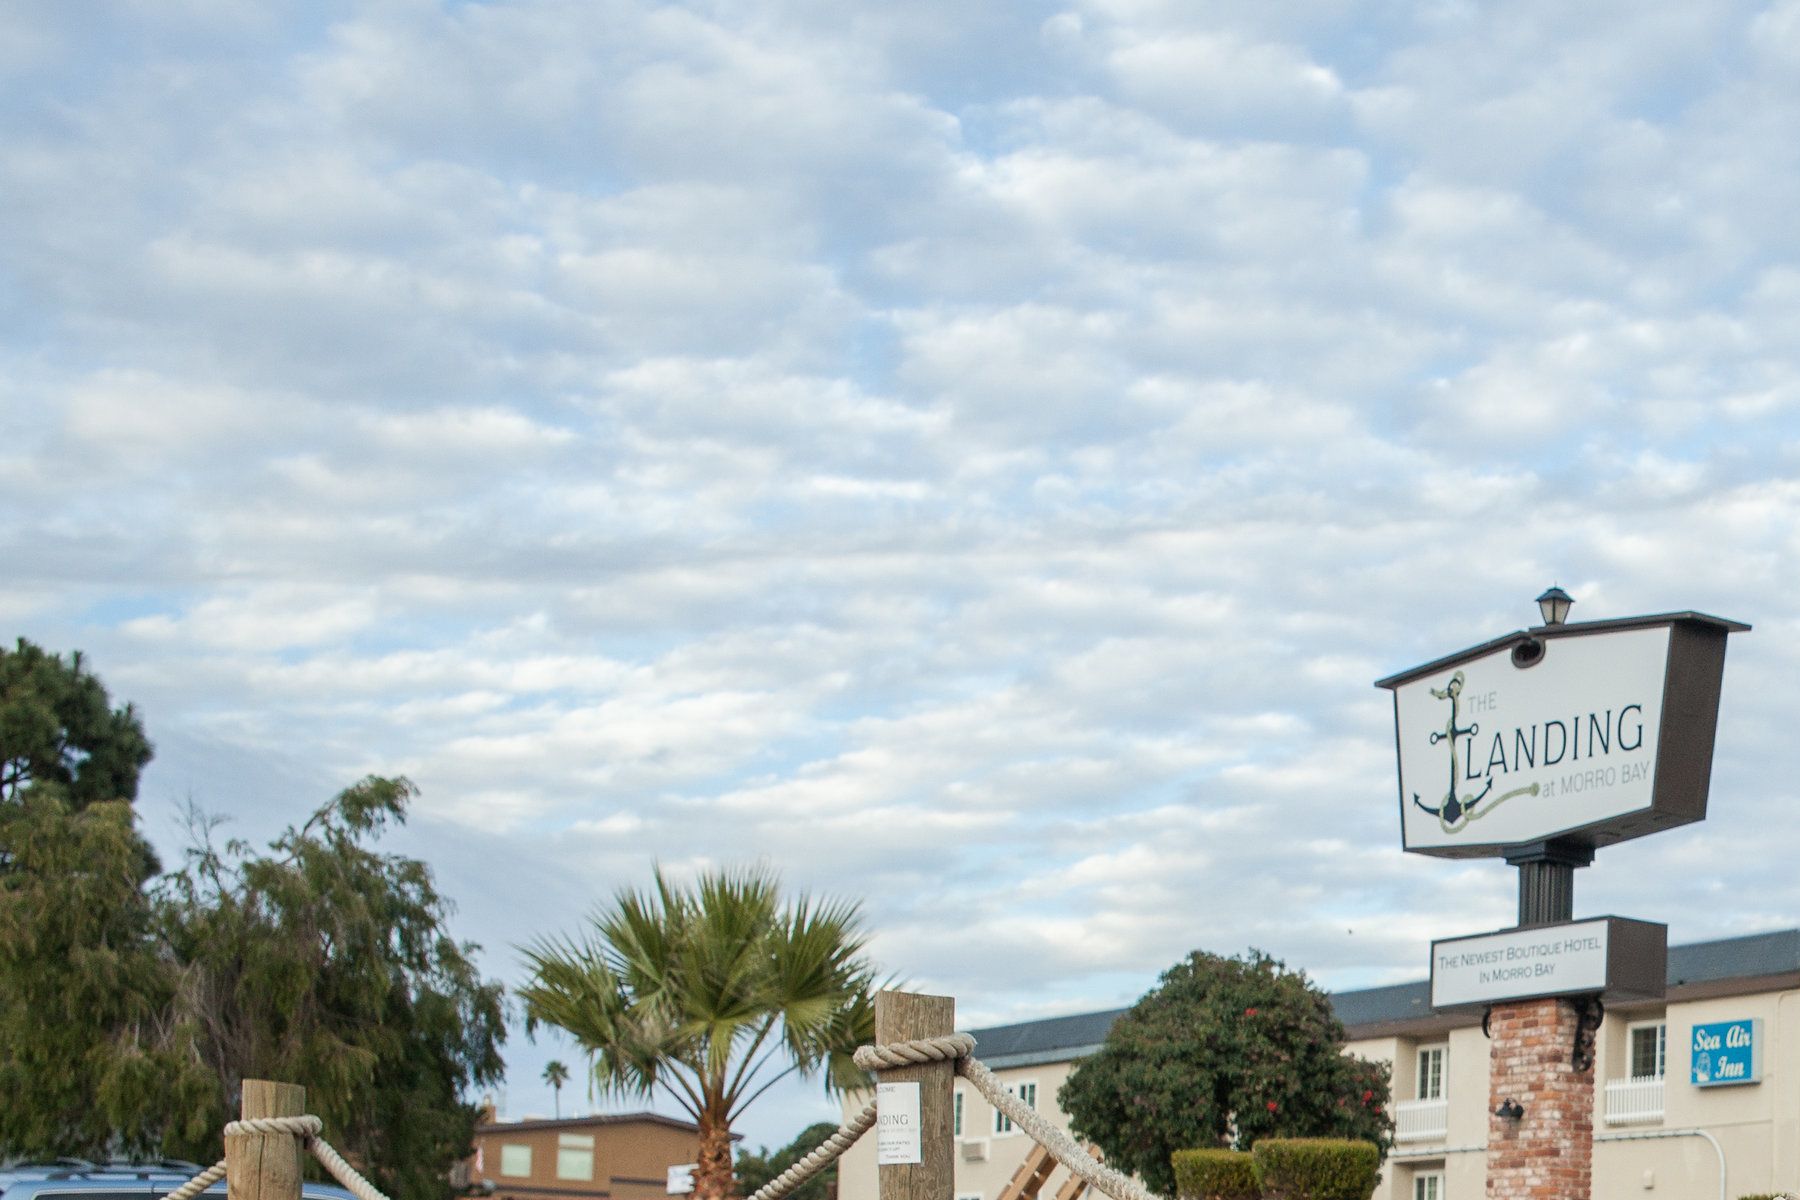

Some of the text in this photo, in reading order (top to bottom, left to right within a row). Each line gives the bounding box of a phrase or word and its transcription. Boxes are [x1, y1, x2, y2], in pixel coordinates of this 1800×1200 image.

[1467, 691, 1498, 714] THE
[1466, 704, 1643, 780] LANDING
[1542, 760, 1651, 798] at MORRO BAY
[1438, 937, 1602, 970] THE NEWEST BOUTIQUE HOTEL
[1479, 963, 1556, 984] IN MORRO BAY
[1693, 1025, 1751, 1052] Sea Air
[1714, 1055, 1744, 1079] Inn
